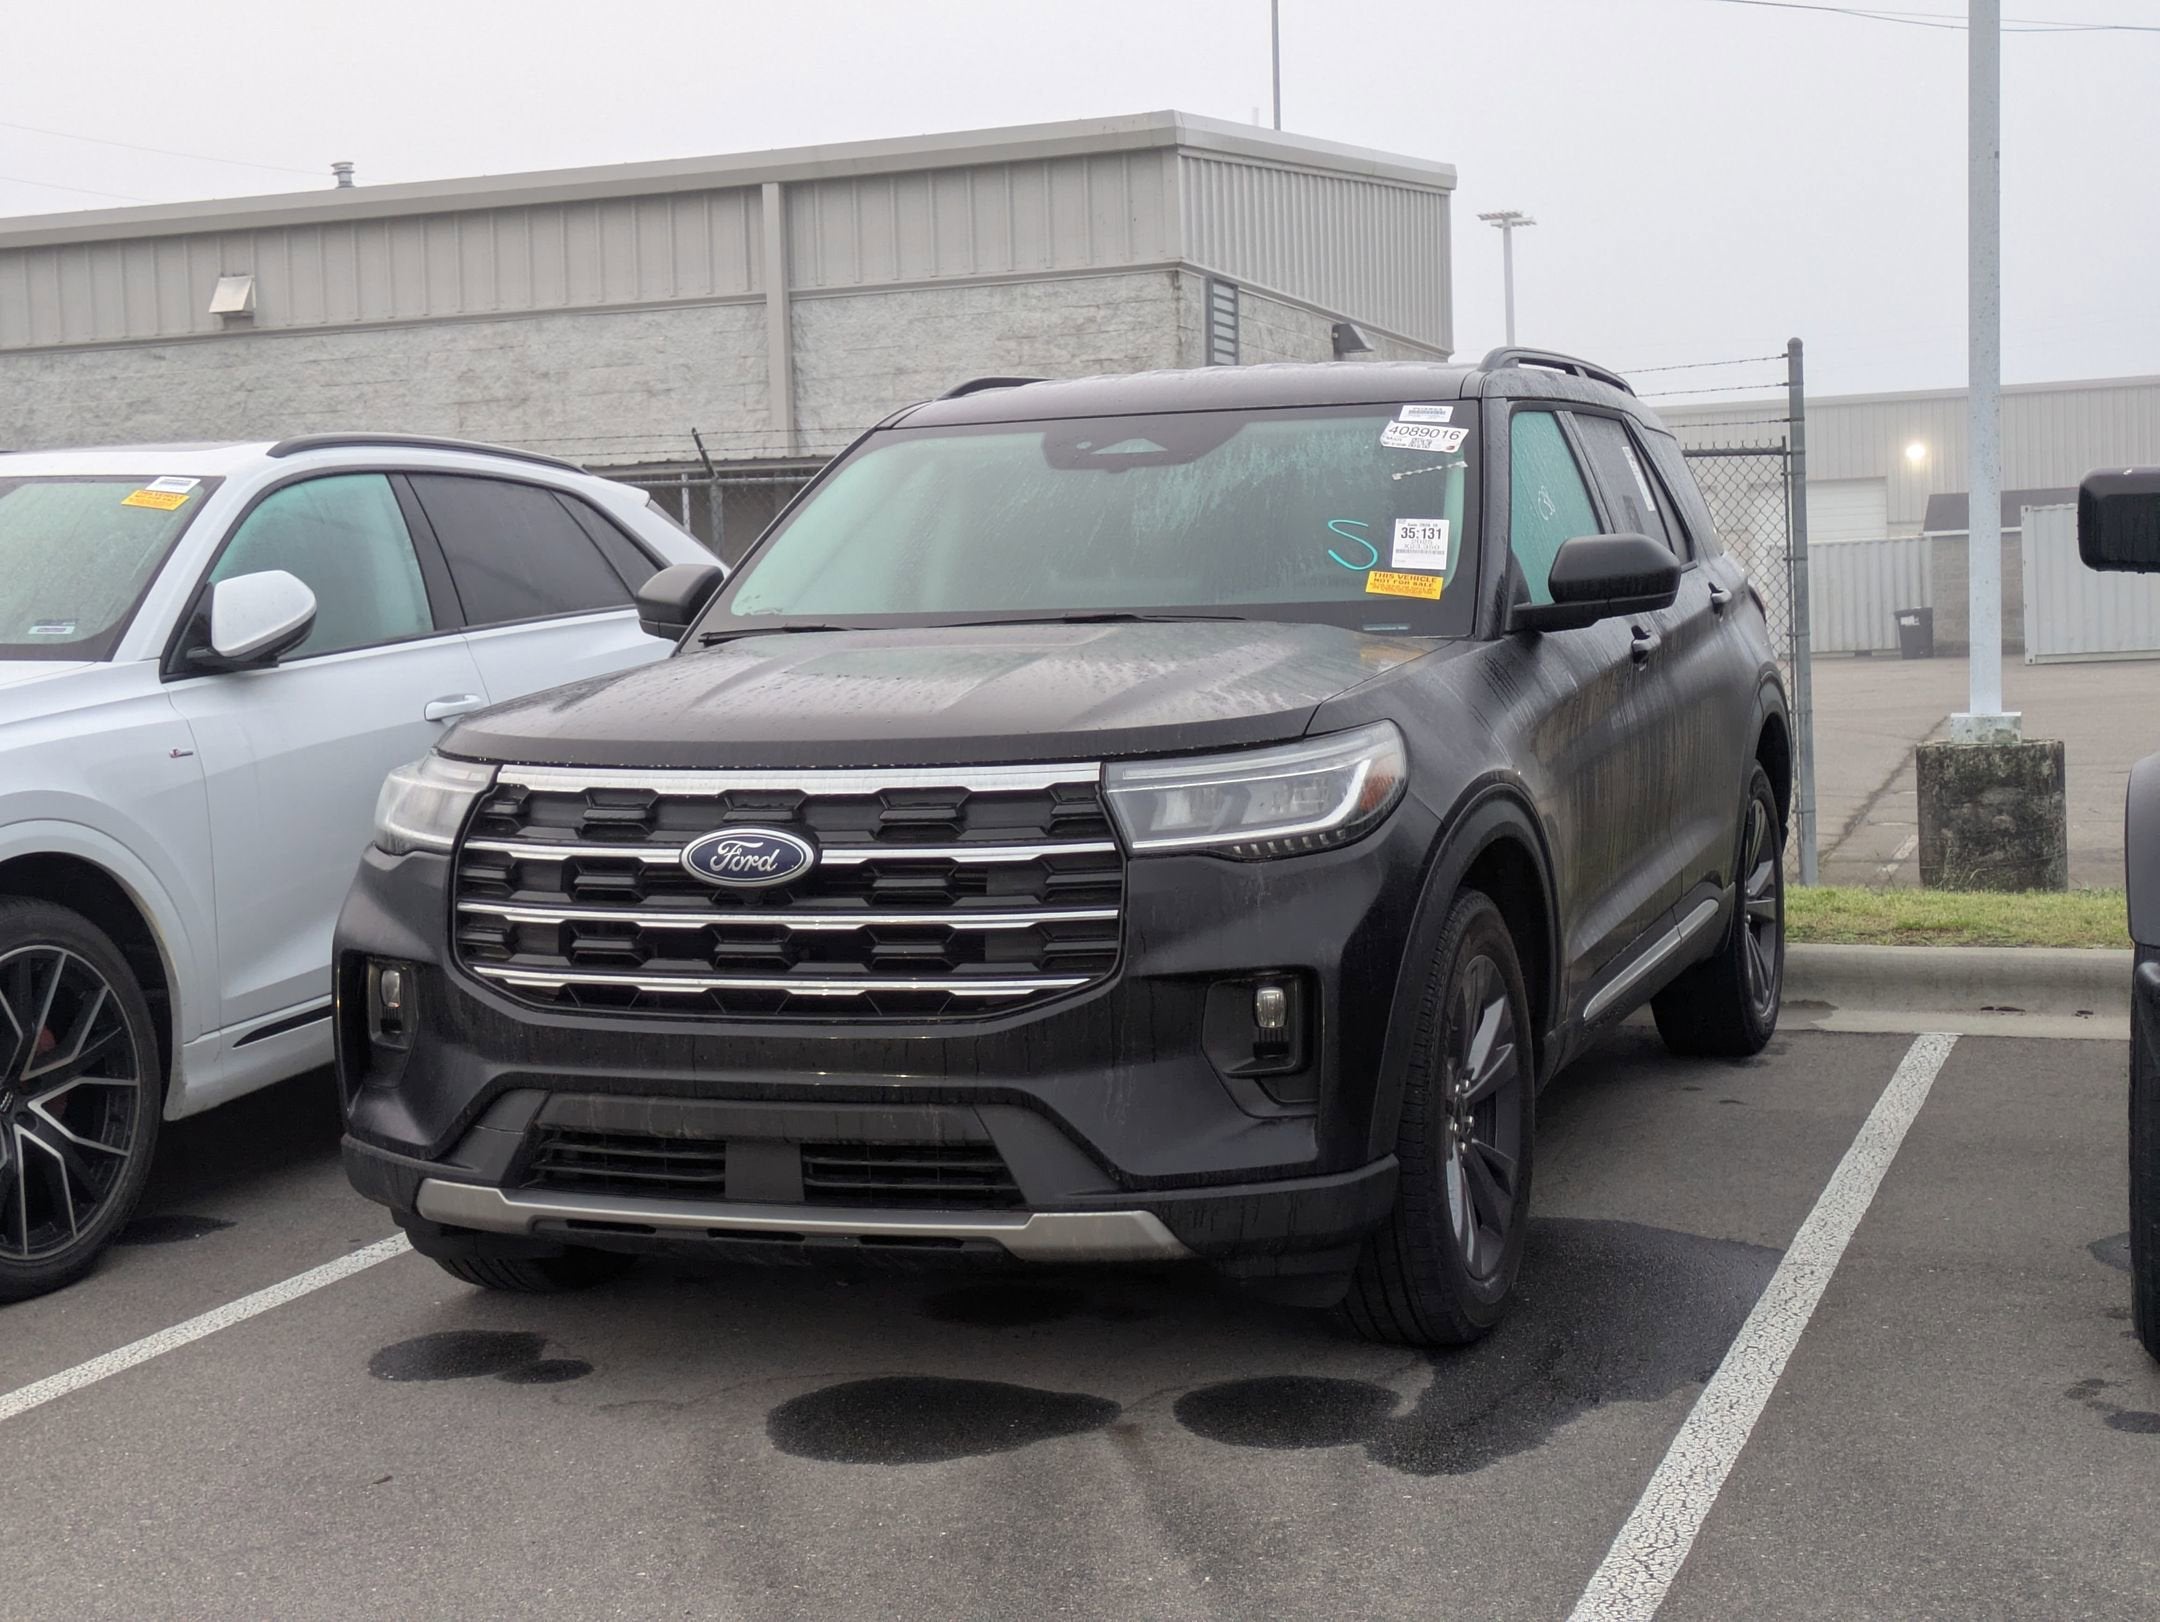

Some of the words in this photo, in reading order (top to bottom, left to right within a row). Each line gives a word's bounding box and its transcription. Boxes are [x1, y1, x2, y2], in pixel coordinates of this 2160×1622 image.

[1388, 425, 1461, 440] 4089016
[1401, 527, 1441, 539] 35:131
[1328, 519, 1377, 570] S
[1397, 574, 1437, 583] VEHICLE
[709, 840, 780, 871] Ford
